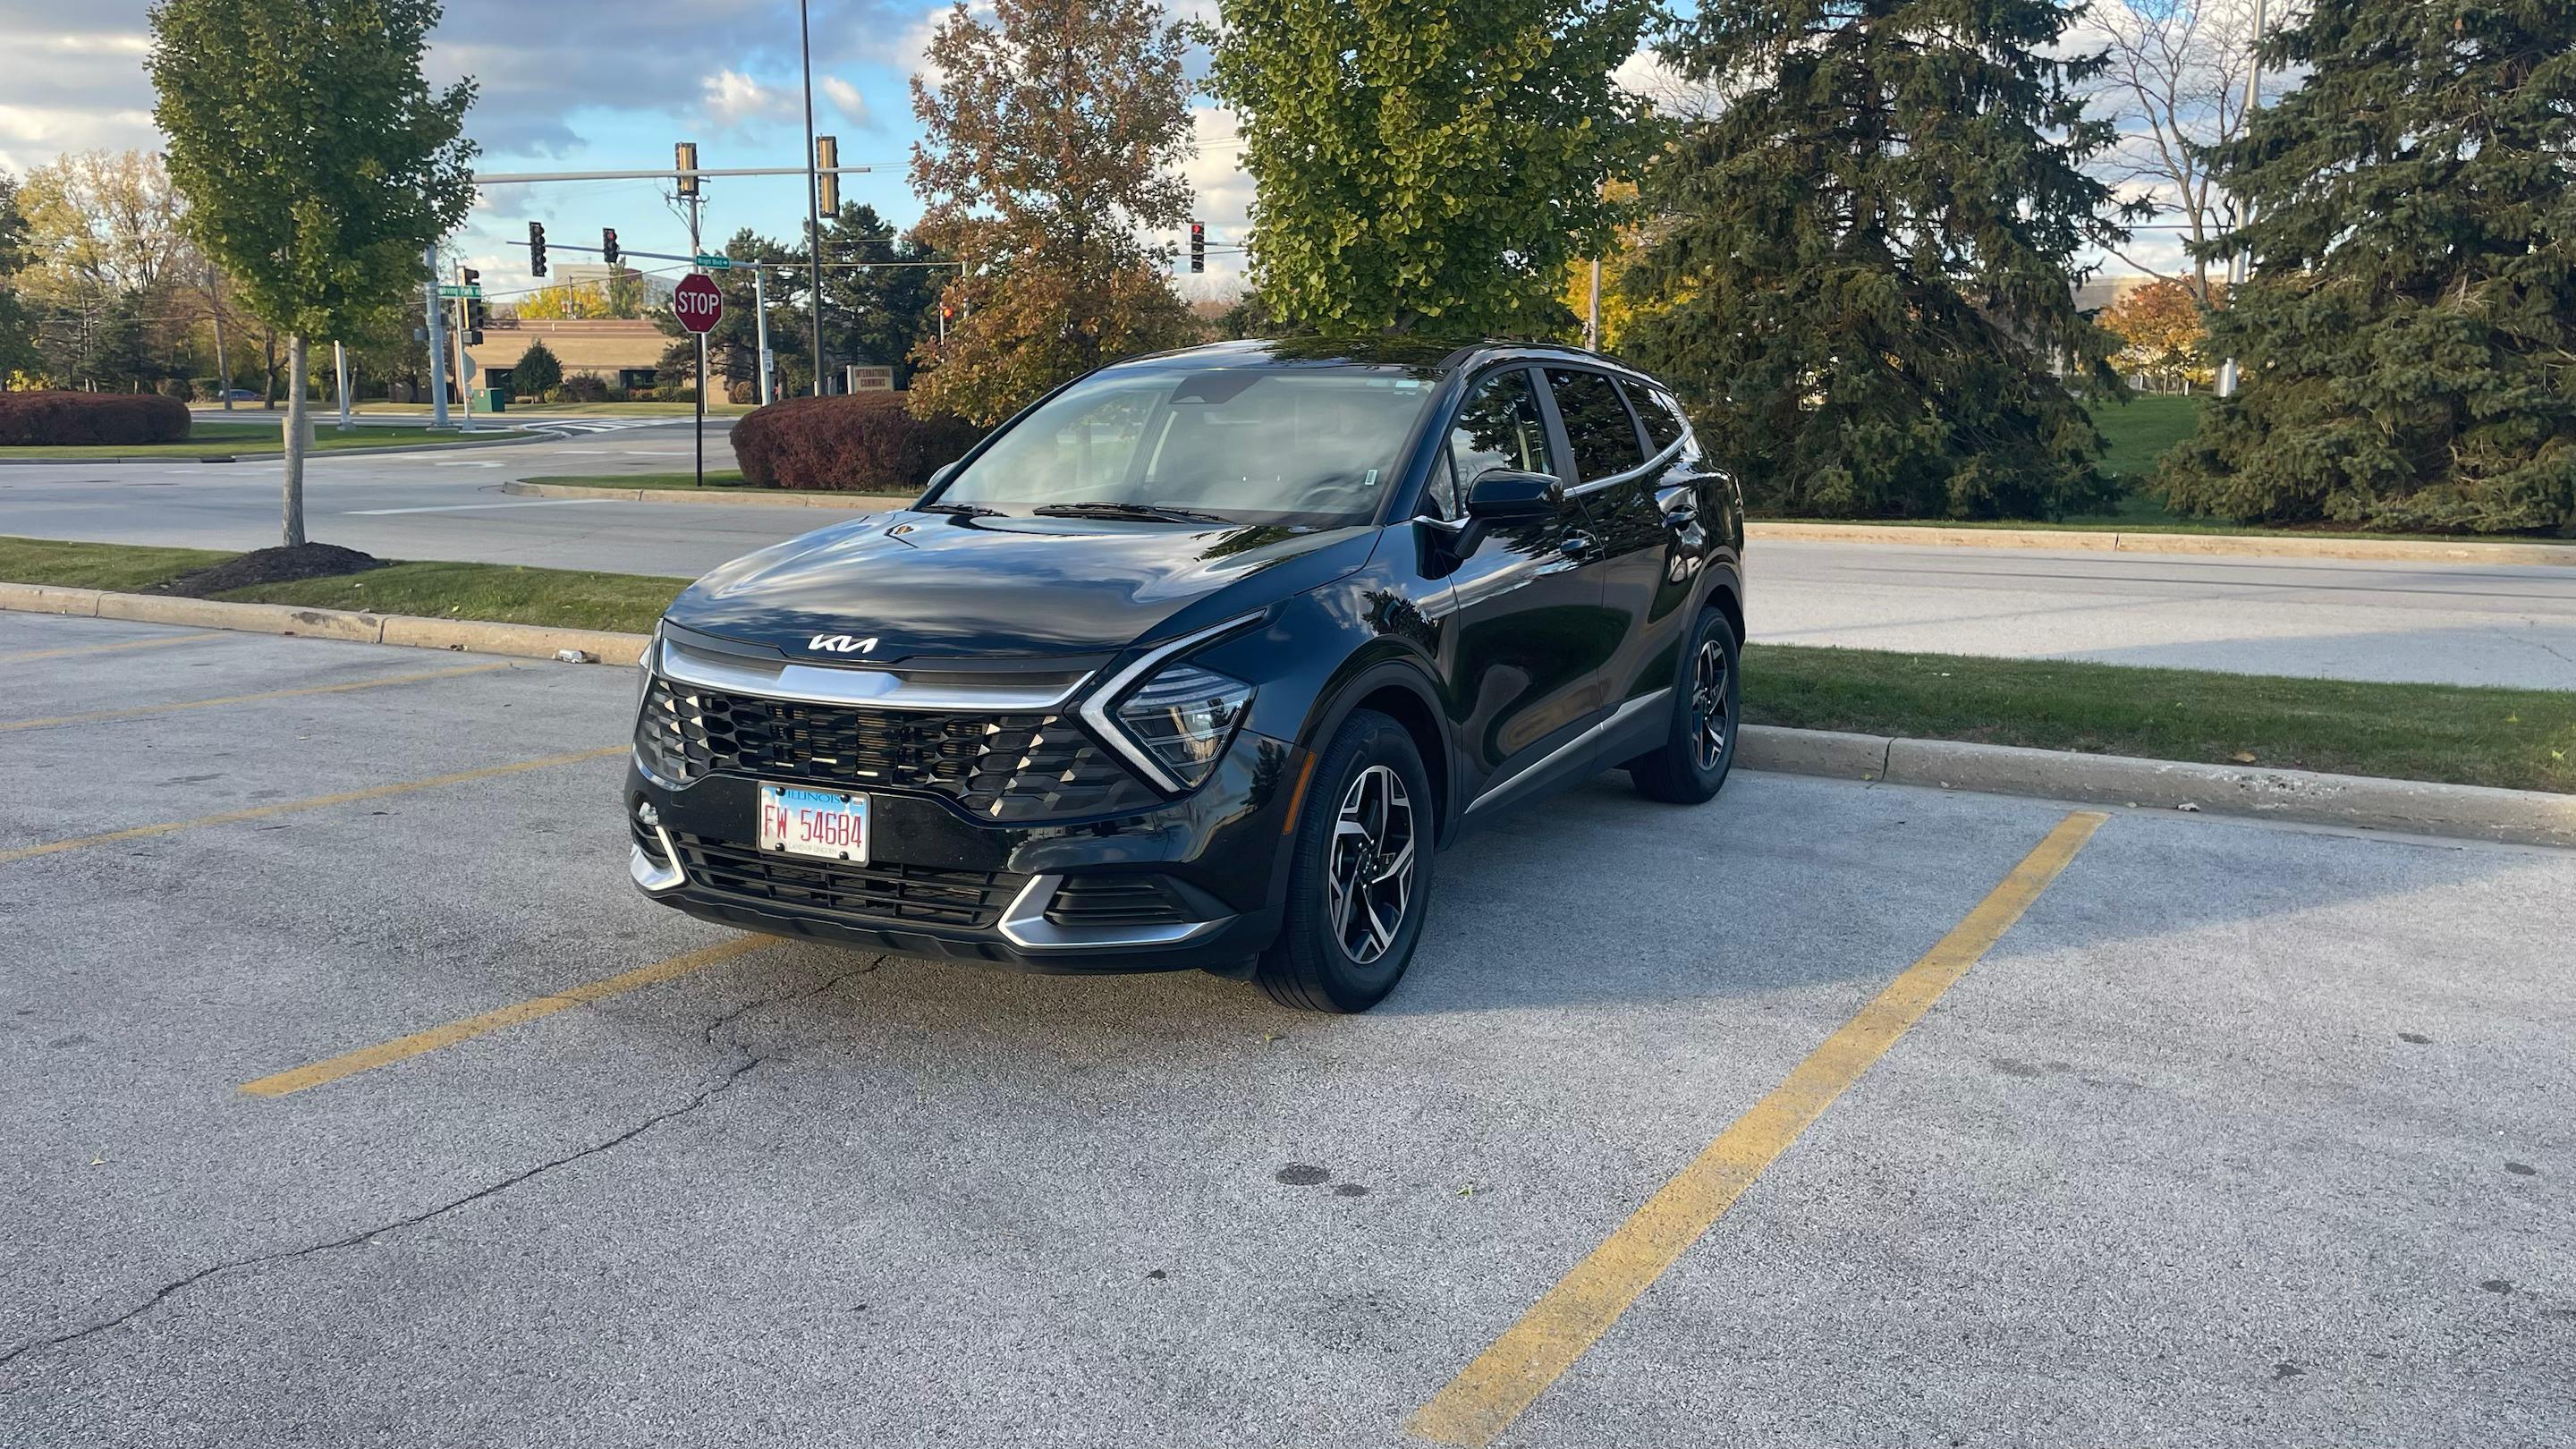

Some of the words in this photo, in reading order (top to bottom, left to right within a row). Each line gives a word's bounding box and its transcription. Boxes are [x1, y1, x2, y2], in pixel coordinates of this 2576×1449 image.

[461, 287, 473, 295] Park
[677, 291, 720, 315] STOP
[855, 369, 891, 377] INTERNATIONAL
[860, 378, 886, 387] COMMONS
[787, 789, 842, 804] ILLINOIS
[765, 803, 788, 839] FW
[801, 807, 862, 849] 54684
